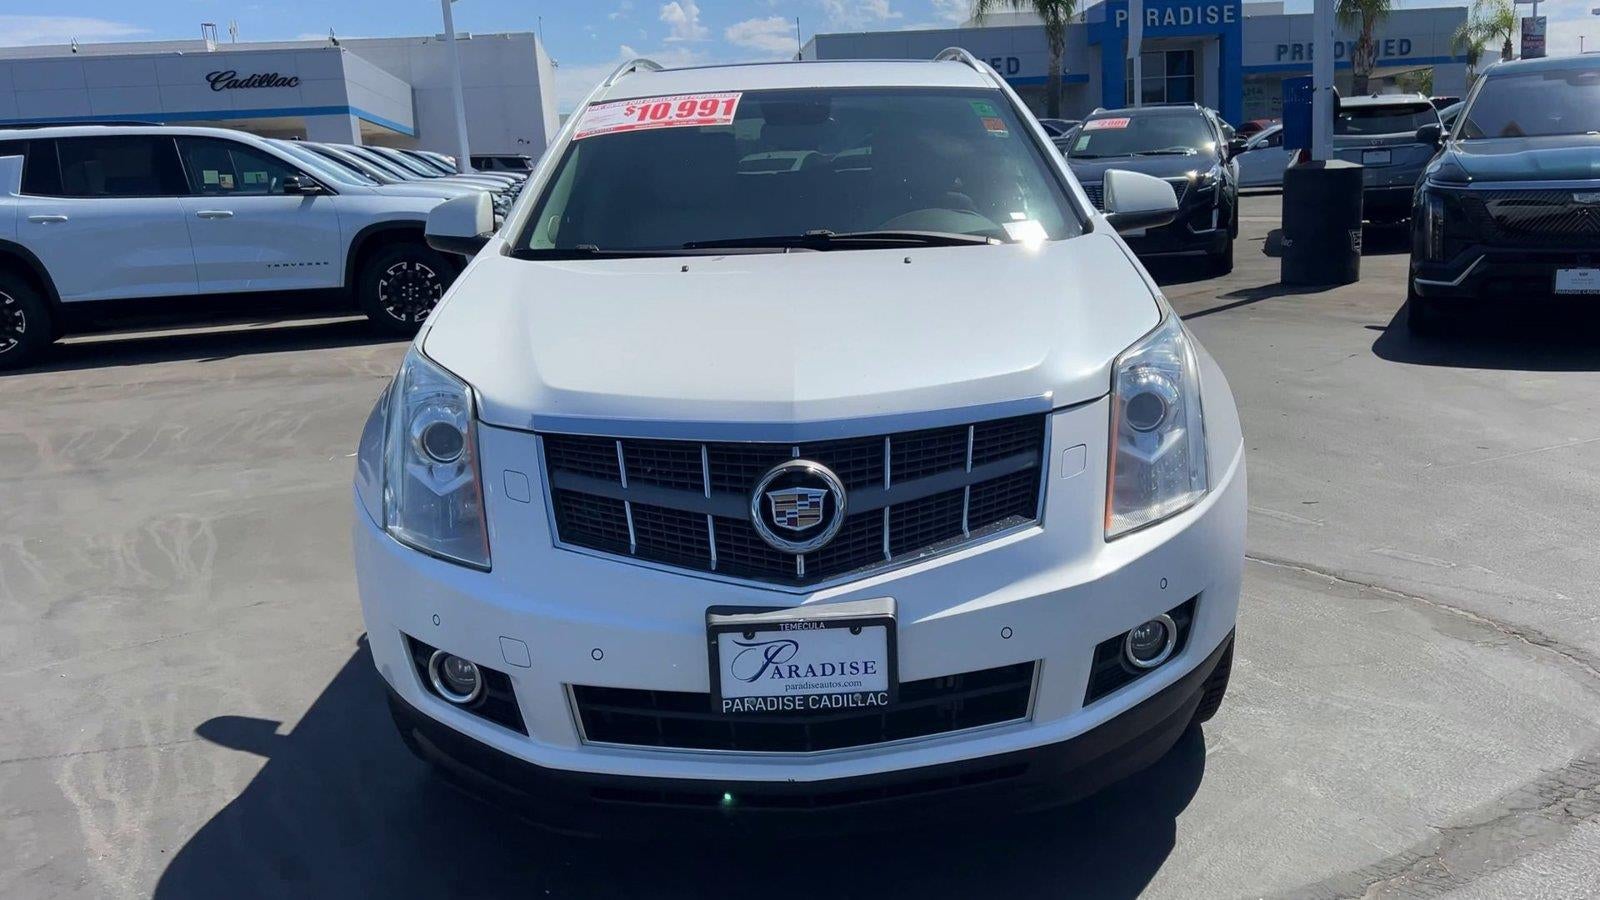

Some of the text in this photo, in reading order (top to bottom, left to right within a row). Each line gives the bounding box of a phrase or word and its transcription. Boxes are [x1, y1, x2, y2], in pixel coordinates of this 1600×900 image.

[1115, 5, 1235, 28] PRADISE
[205, 70, 300, 91] Cadillac
[779, 621, 826, 631] TEMECULA
[785, 680, 862, 691] paradiseautos.com
[722, 692, 888, 713] PARADISE CADILLAC
